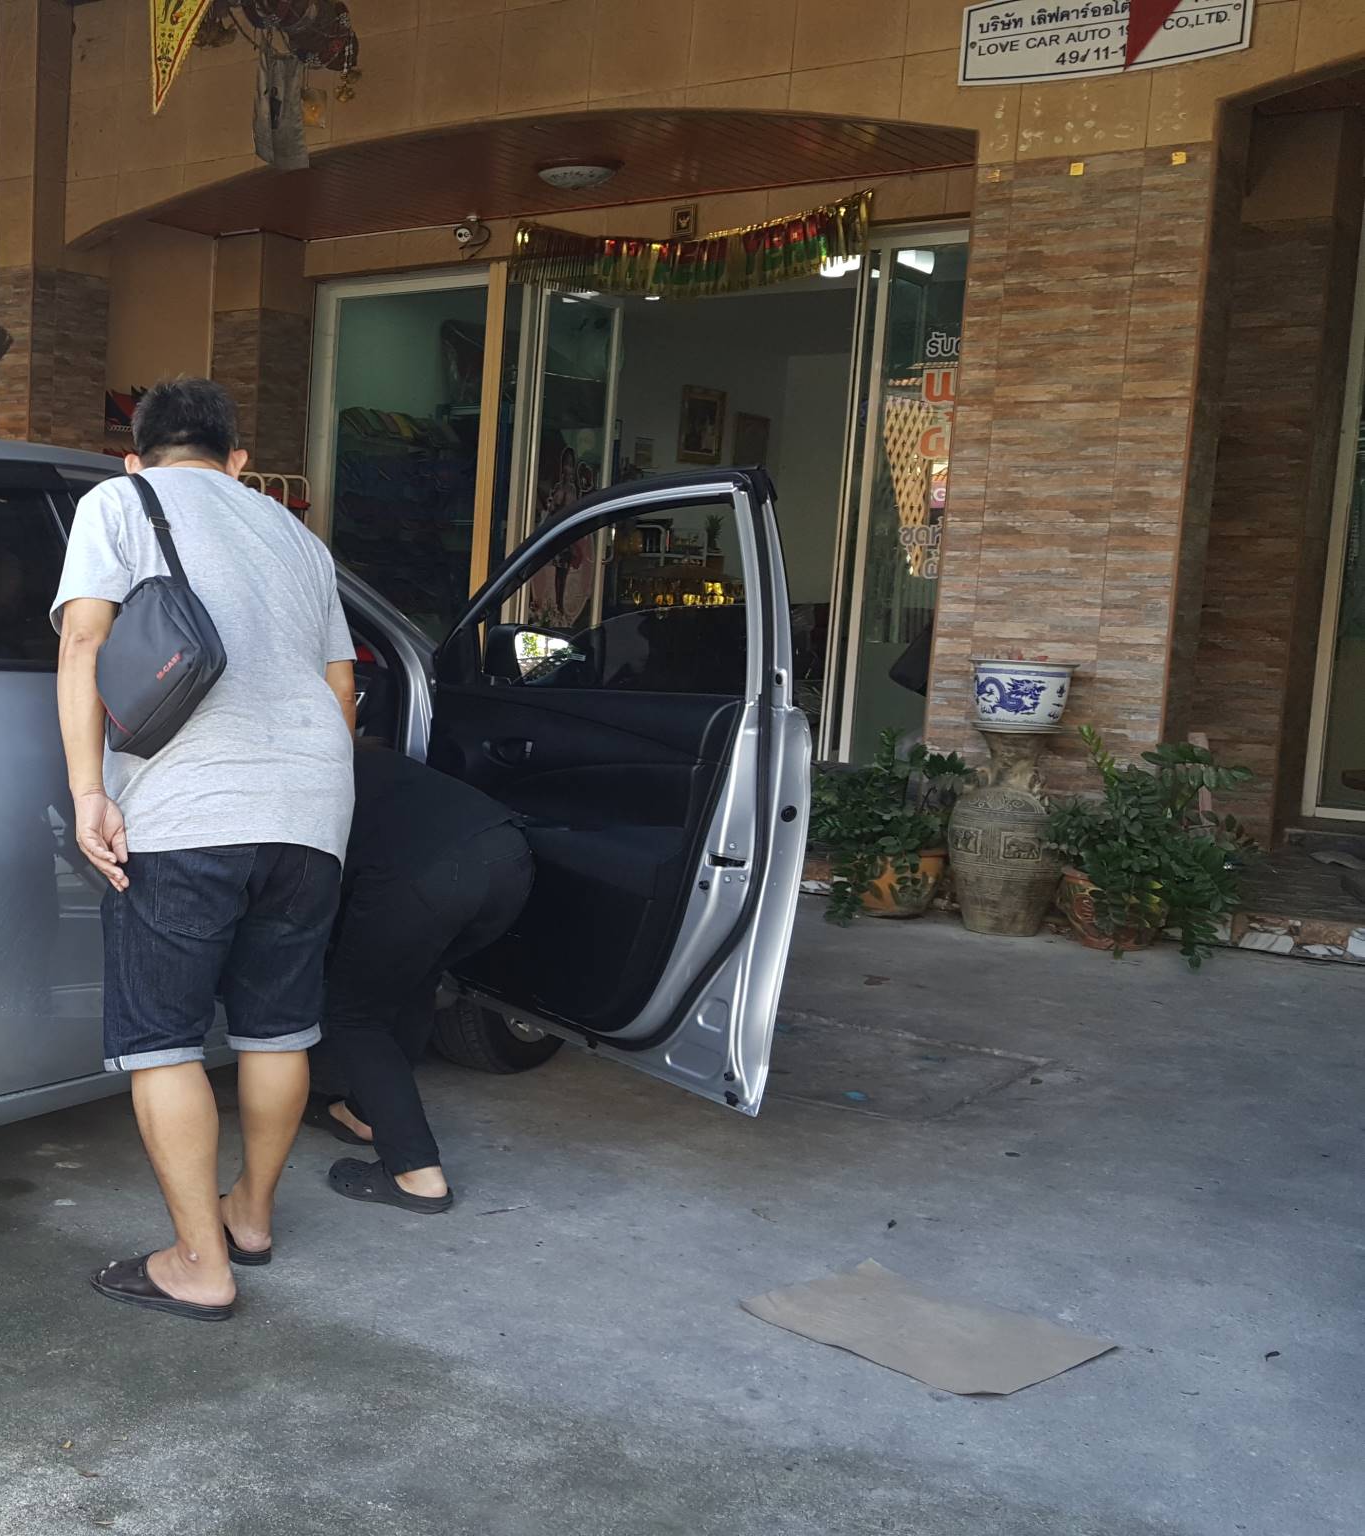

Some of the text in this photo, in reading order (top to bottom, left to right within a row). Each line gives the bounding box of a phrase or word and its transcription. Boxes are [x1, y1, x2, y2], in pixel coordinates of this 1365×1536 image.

[979, 12, 1023, 34] บริษัท
[978, 39, 1020, 57] LOVE
[1026, 34, 1061, 50] CAR
[1066, 27, 1111, 44] AUTO
[1056, 43, 1127, 66] 49/11-1
